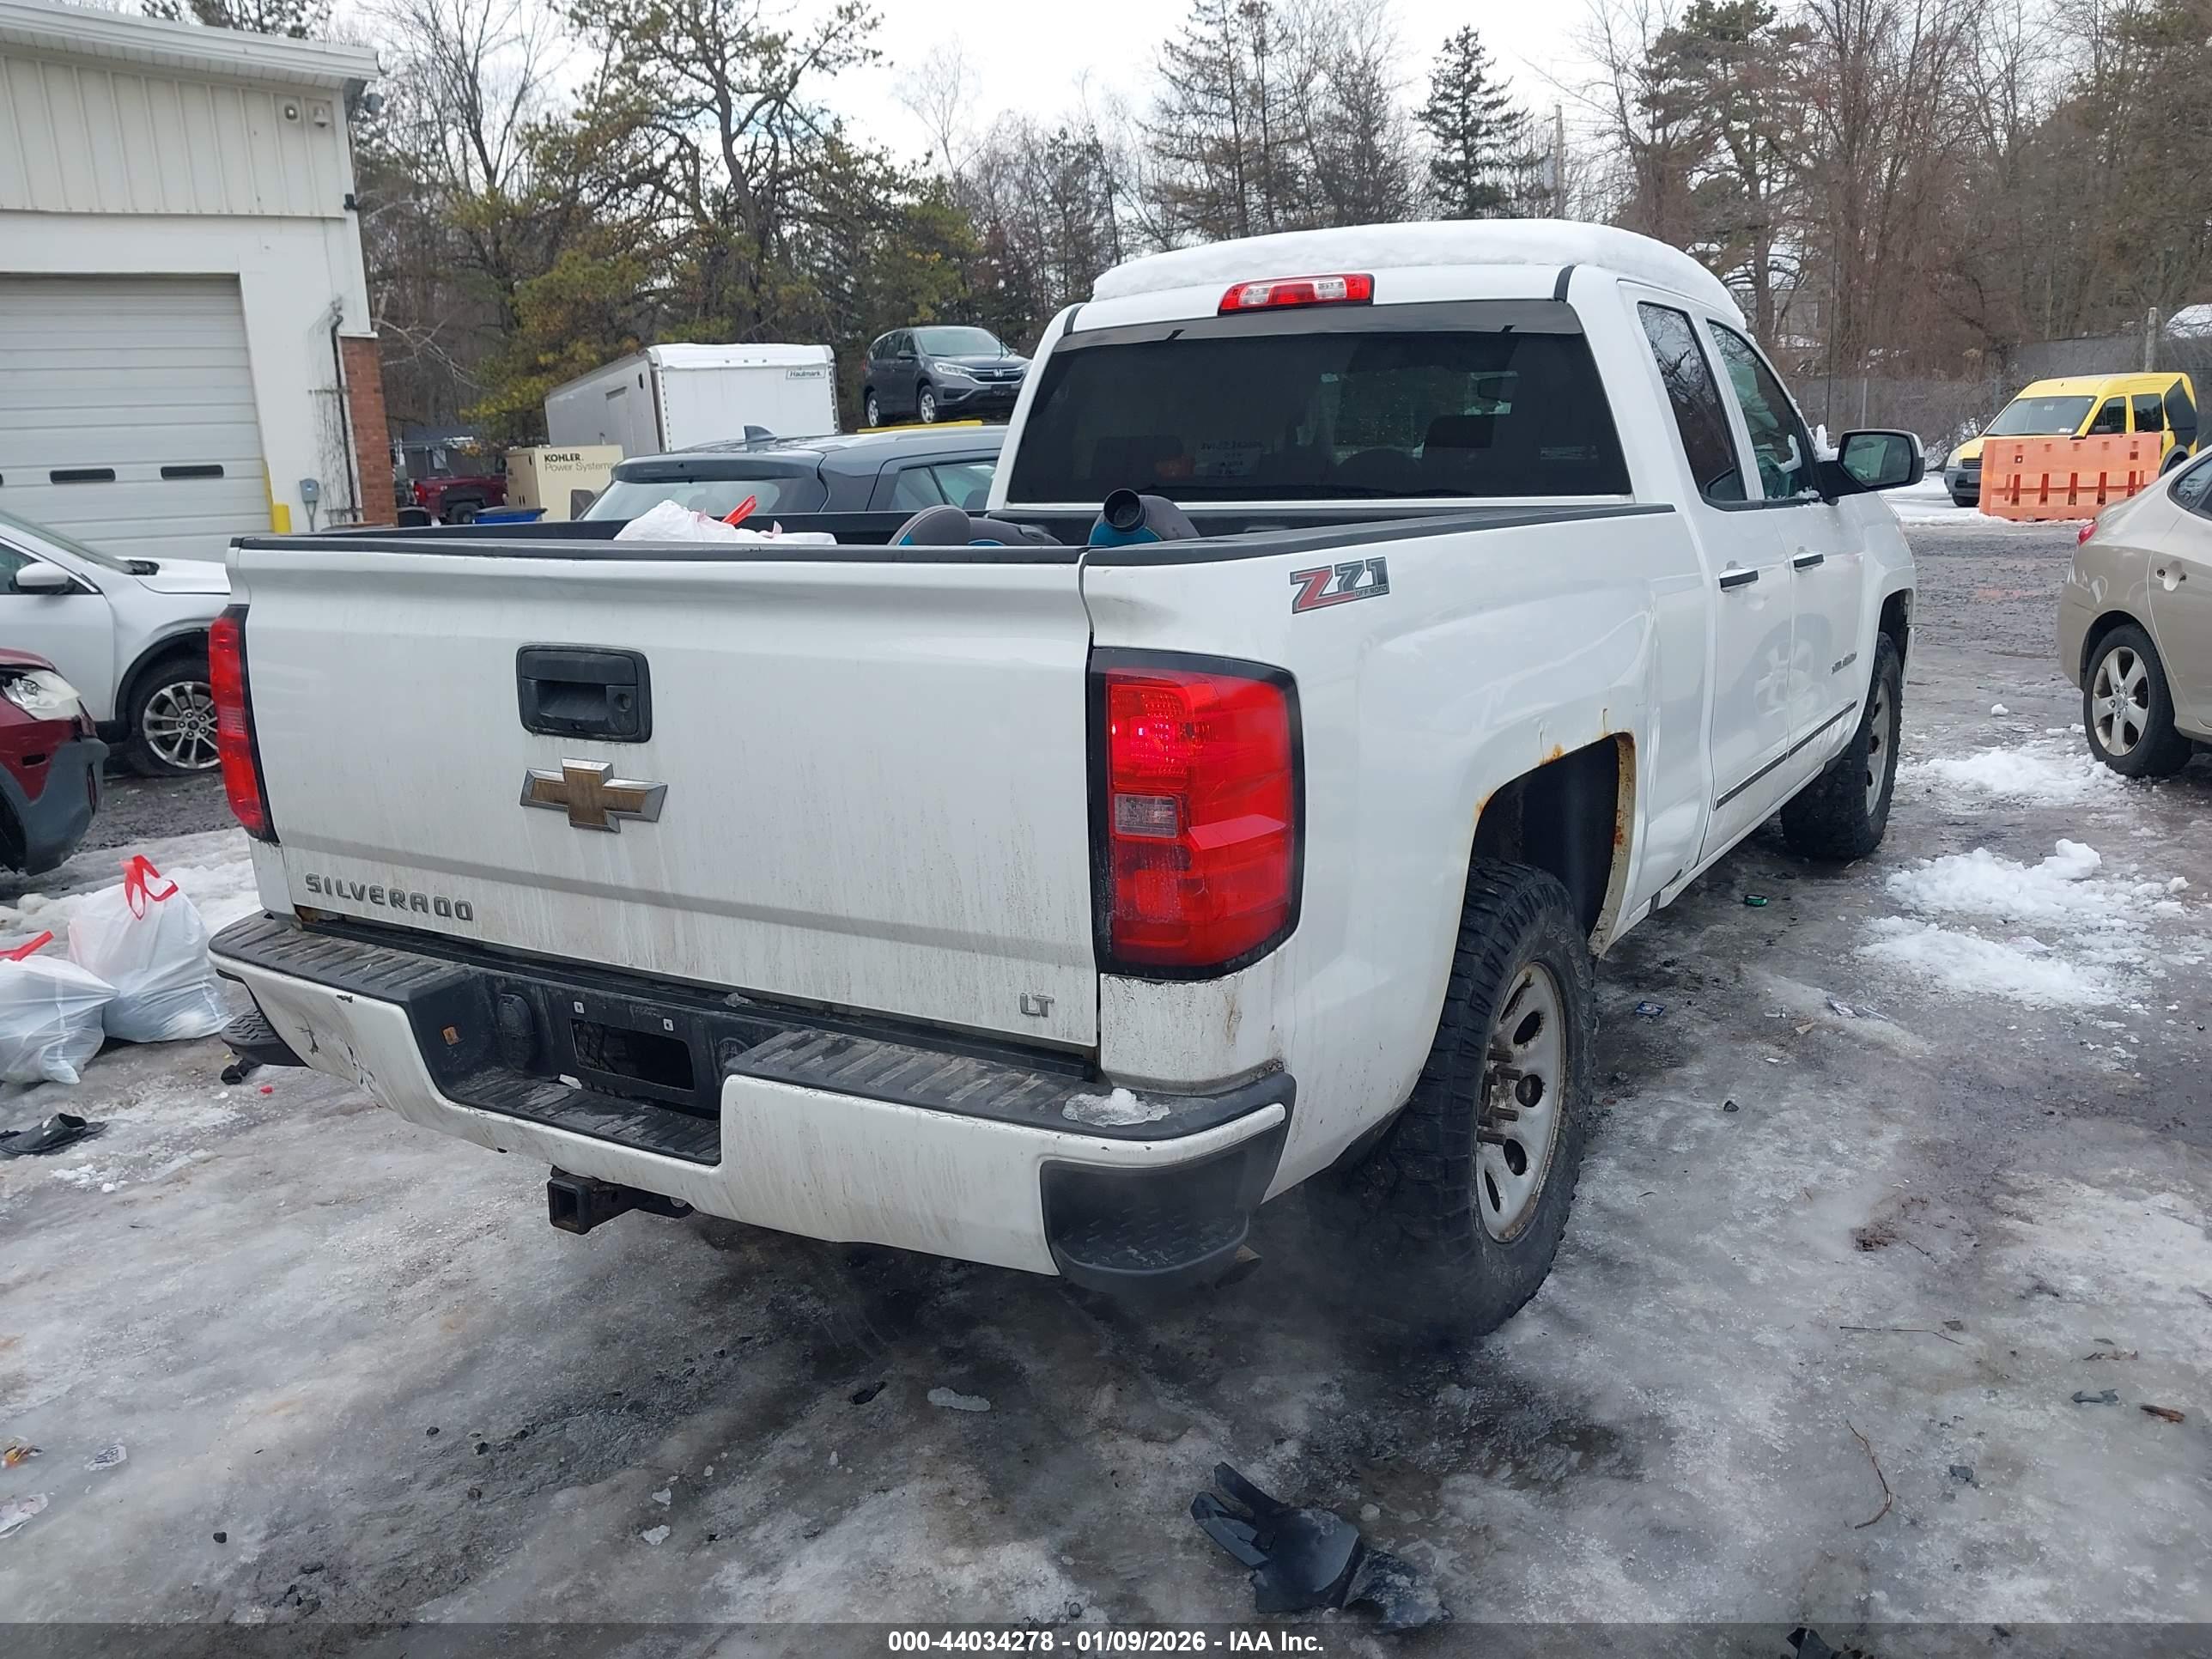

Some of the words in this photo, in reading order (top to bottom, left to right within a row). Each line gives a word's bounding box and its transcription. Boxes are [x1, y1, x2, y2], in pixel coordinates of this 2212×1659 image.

[544, 463, 573, 473] Power
[1290, 556, 1389, 614] Z71
[1355, 589, 1369, 598] OFF
[1370, 585, 1388, 593] ROAD
[305, 872, 474, 921] SILVERADO
[1020, 992, 1054, 1018] LT
